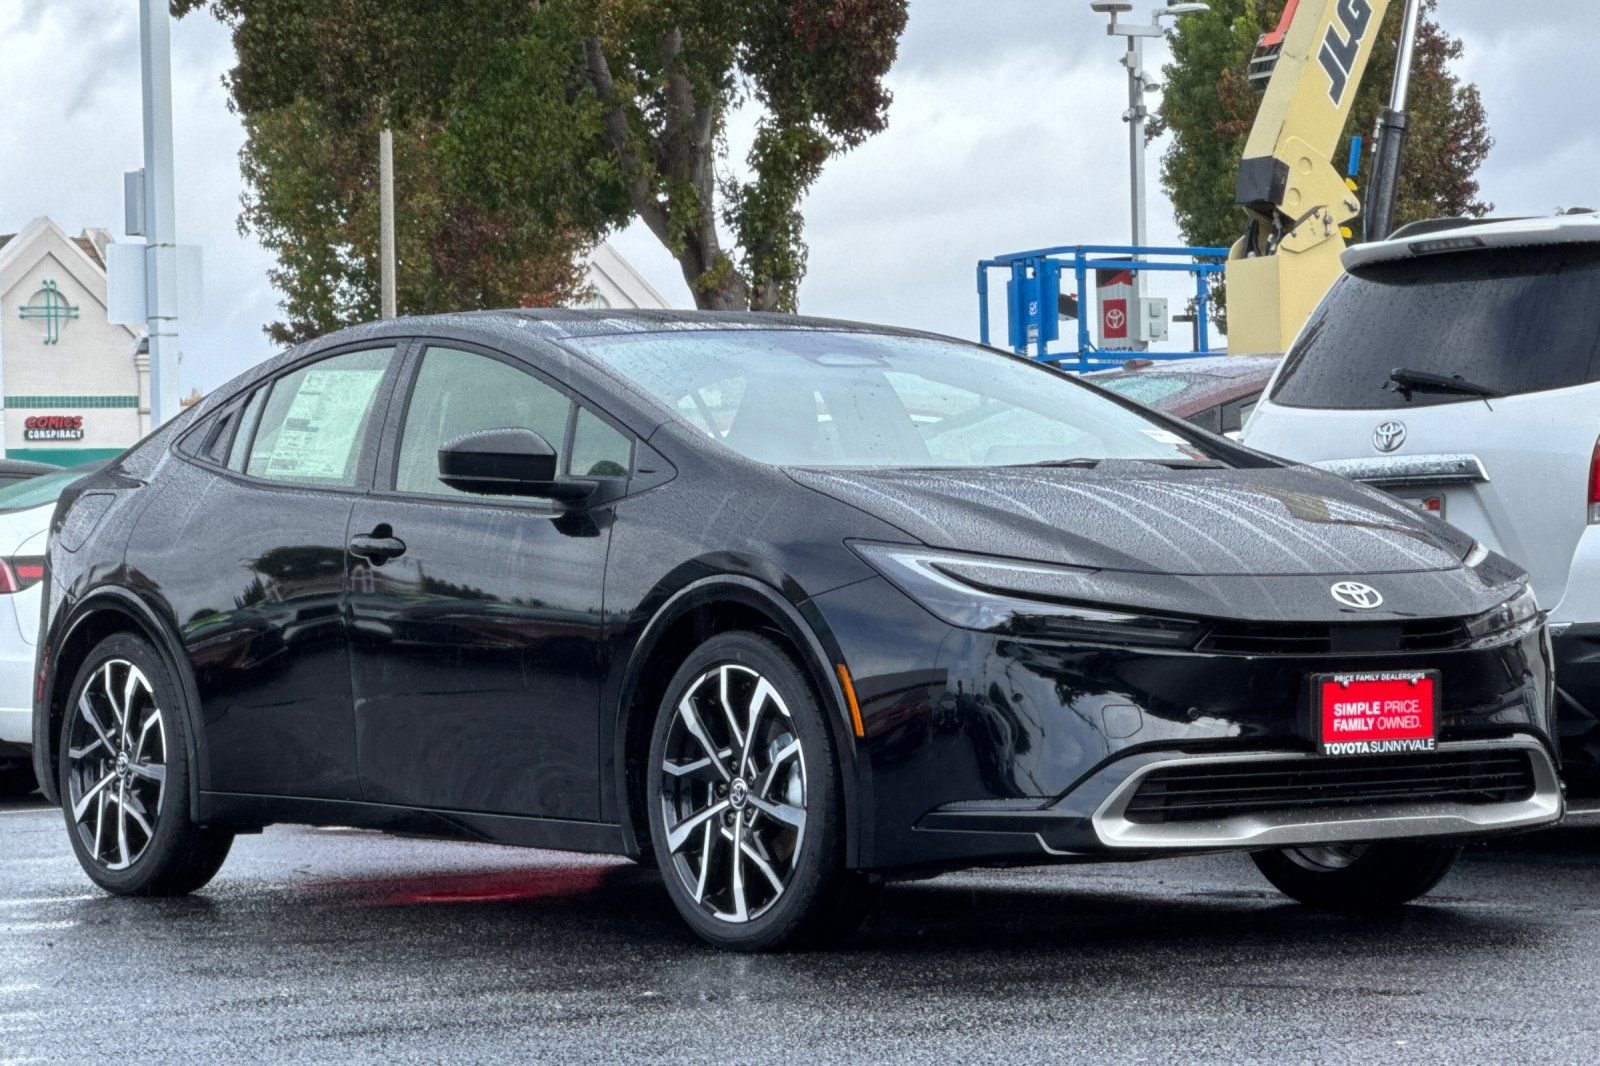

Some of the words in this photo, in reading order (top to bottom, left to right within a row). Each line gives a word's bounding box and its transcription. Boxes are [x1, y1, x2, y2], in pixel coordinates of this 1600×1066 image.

[1316, 0, 1374, 109] JLG
[25, 416, 83, 429] COMICS
[28, 430, 81, 438] CONSPIRACY
[1334, 674, 1354, 682] PRICE
[1356, 674, 1379, 682] FAMILY
[1381, 672, 1425, 681] DEALERSHIPS
[1334, 702, 1381, 716] SIMPLE
[1384, 699, 1422, 714] PRICE.
[1333, 718, 1375, 731] FAMILY
[1377, 715, 1422, 730] OWNED.
[1324, 742, 1369, 755] TOYOTA
[1370, 738, 1435, 753] SUNNYVALE
